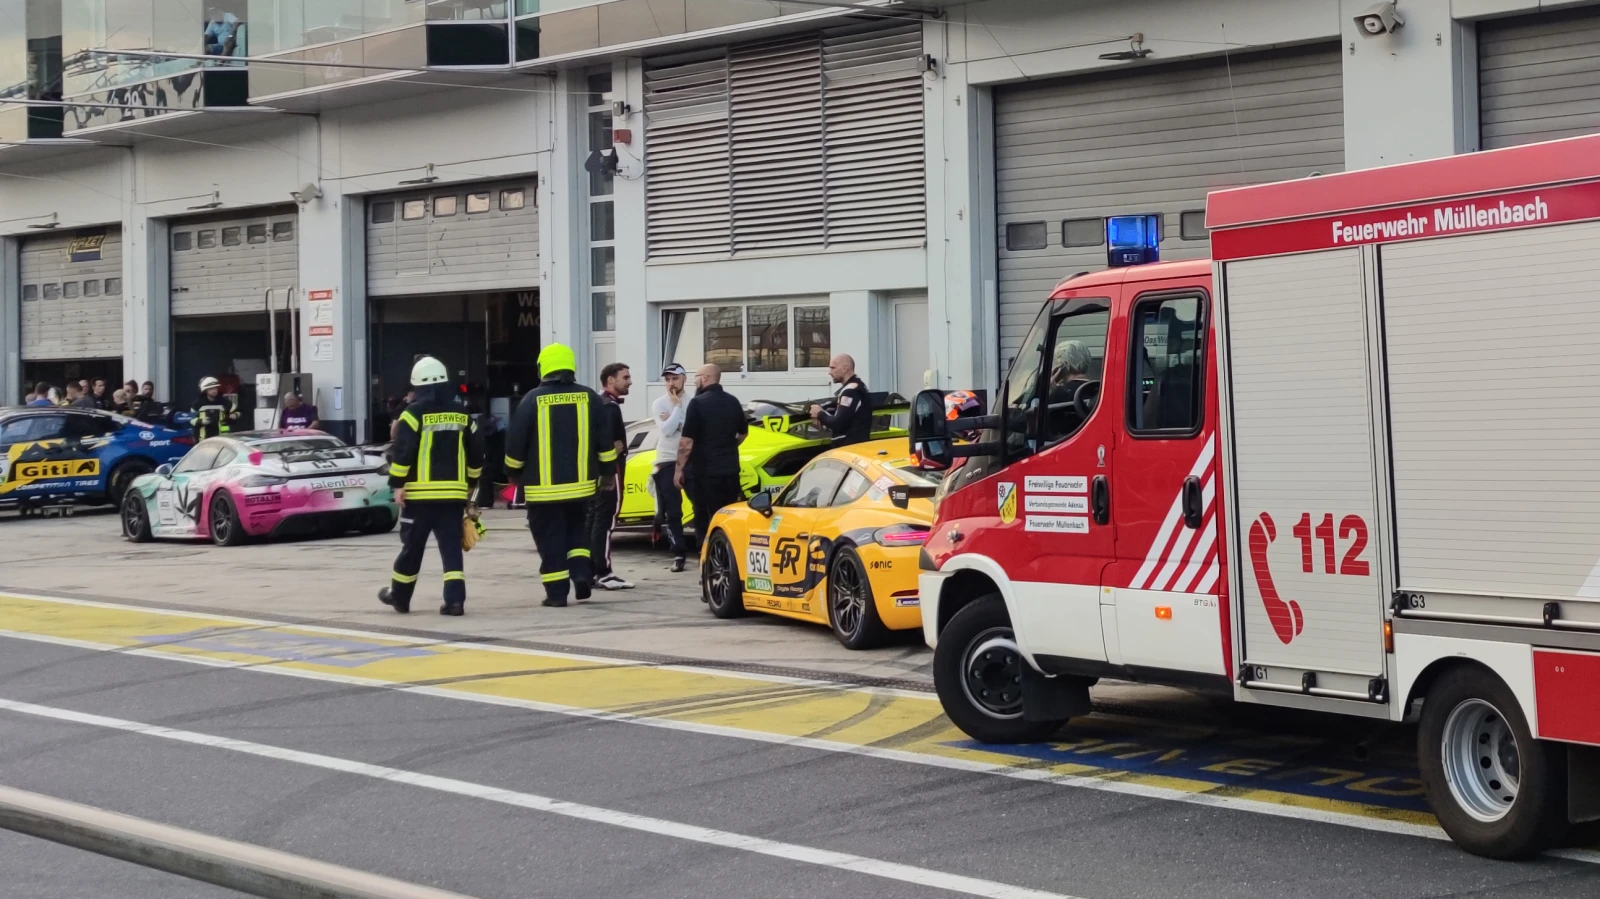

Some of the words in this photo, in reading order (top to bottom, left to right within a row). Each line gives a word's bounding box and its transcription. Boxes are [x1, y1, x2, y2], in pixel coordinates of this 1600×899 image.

[1332, 212, 1428, 243] Feuerwehr
[1434, 196, 1548, 232] Müllenbach
[538, 393, 587, 404] FEUERWEHR
[424, 413, 467, 424] FEUERWEHR
[21, 464, 68, 477] Giti
[16, 482, 71, 490] COMPETITION
[1055, 481, 1083, 489] Feuerwehr
[1029, 520, 1055, 528] Feuerwehr
[1293, 512, 1370, 576] 112
[749, 551, 769, 574] 952
[1410, 594, 1426, 609] G3
[1255, 666, 1268, 680] G1
